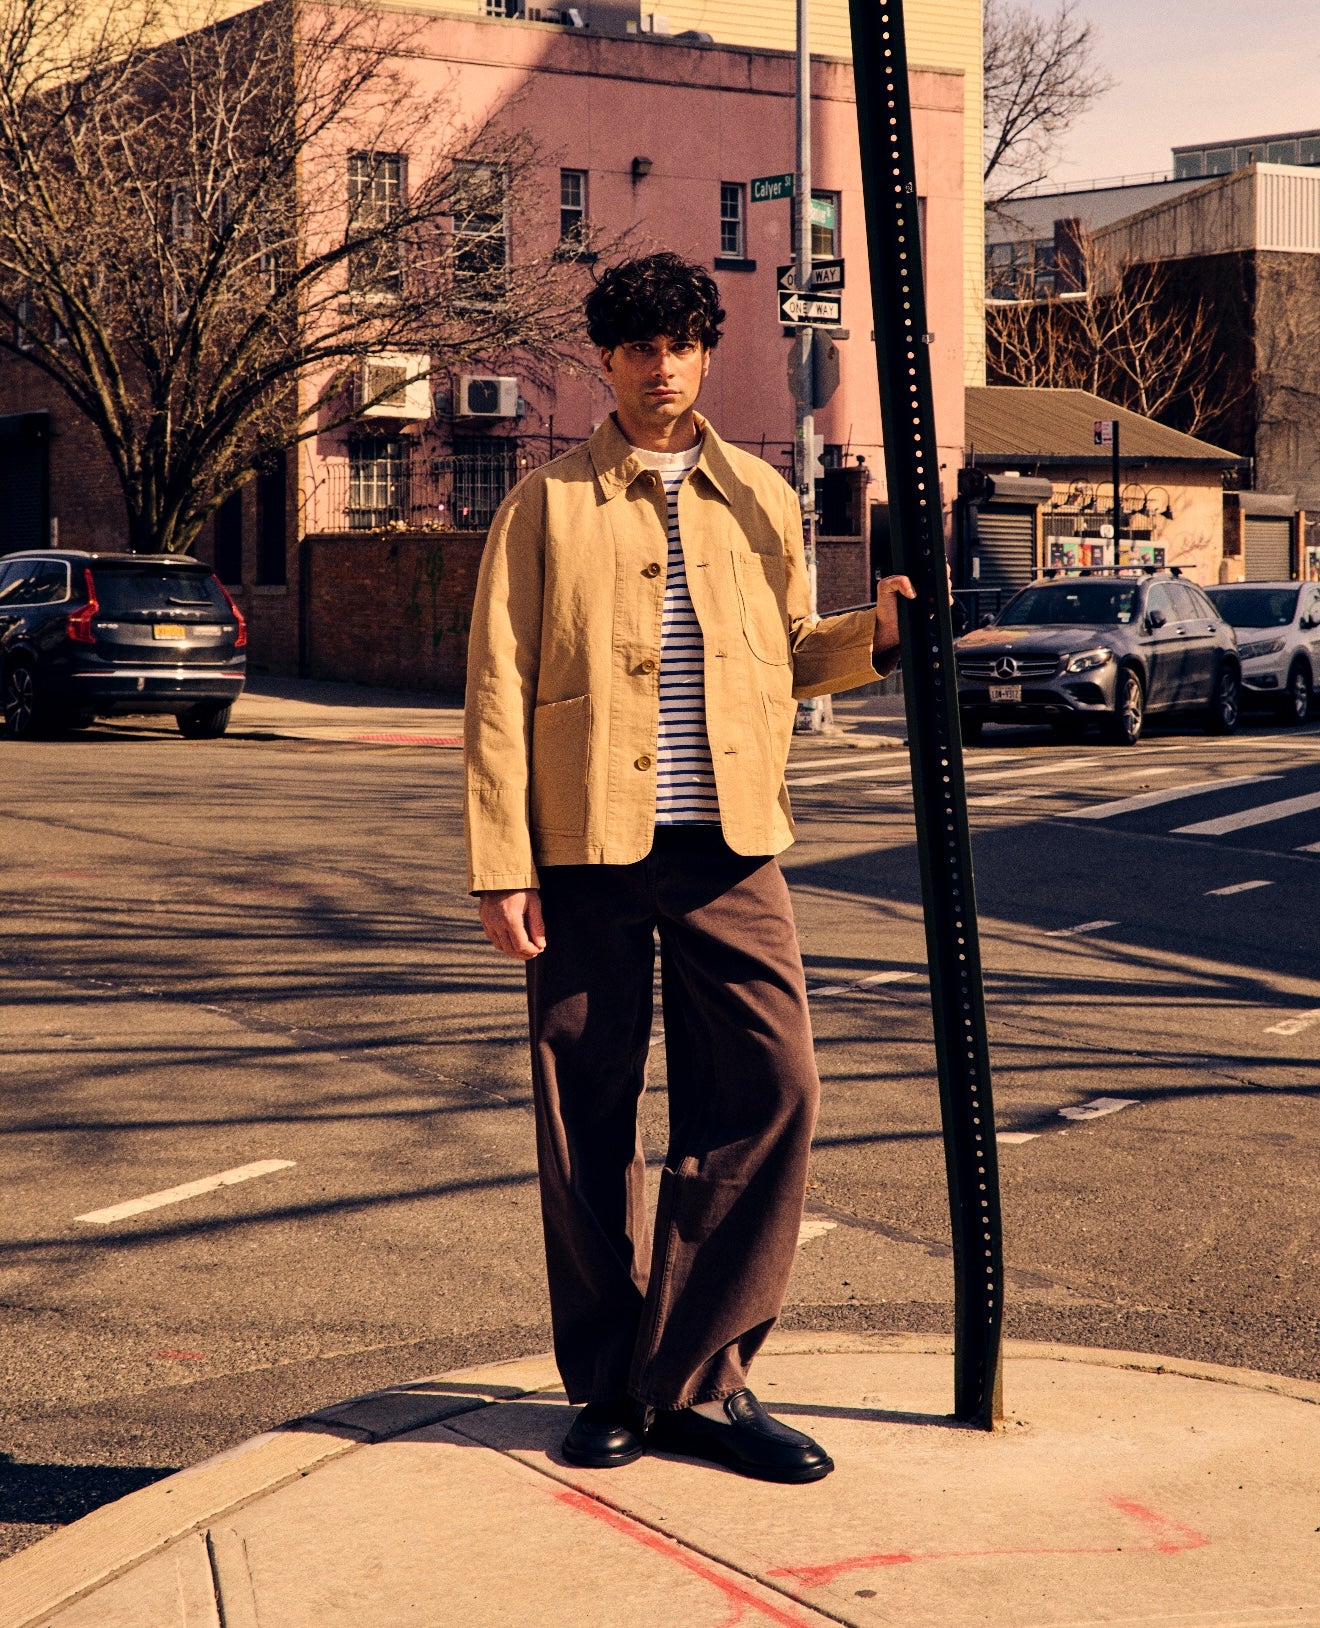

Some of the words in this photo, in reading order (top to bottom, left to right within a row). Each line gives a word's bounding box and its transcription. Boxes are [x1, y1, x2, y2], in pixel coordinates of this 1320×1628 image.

[754, 181, 782, 199] Calyer
[784, 175, 791, 187] St
[815, 268, 837, 283] WAY
[789, 301, 808, 314] ONE
[815, 303, 834, 316] WAY
